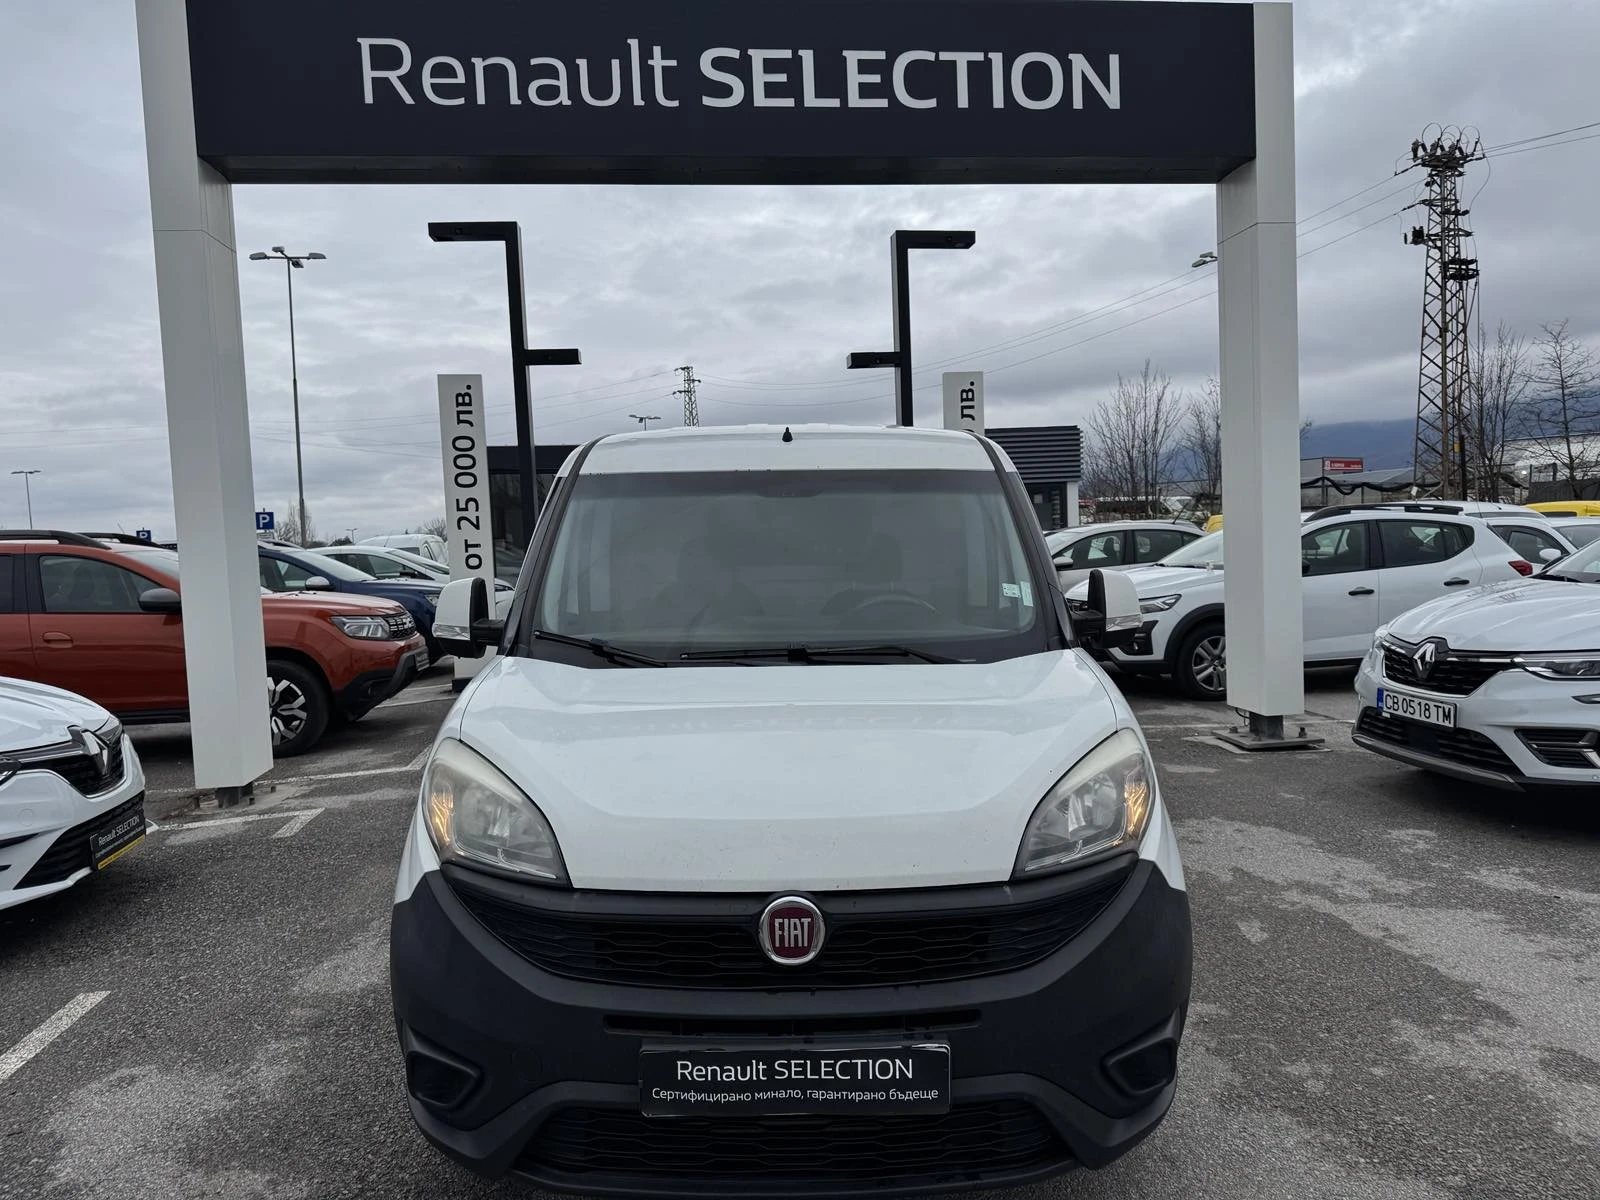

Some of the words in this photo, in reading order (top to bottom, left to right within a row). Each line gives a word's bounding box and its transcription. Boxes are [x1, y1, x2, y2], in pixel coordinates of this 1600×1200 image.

[356, 37, 680, 108] Renault
[699, 46, 1122, 111] SELECTION
[456, 384, 474, 427] лв.
[452, 435, 478, 488] 000
[259, 514, 270, 528] P
[456, 497, 480, 530] 25
[464, 539, 483, 570] от
[1384, 693, 1400, 712] CB
[1401, 698, 1431, 719] 0518
[1433, 704, 1452, 725] TM
[98, 828, 117, 847] Renault
[115, 814, 140, 837] SELECTION
[774, 917, 812, 948] FIAT
[676, 1060, 767, 1081] Renault
[774, 1058, 914, 1081] SELECTION
[651, 1087, 752, 1104] Сертифицирано
[754, 1087, 805, 1101] минало,
[806, 1089, 887, 1102] гарантирано
[889, 1088, 939, 1102] бъдеще
